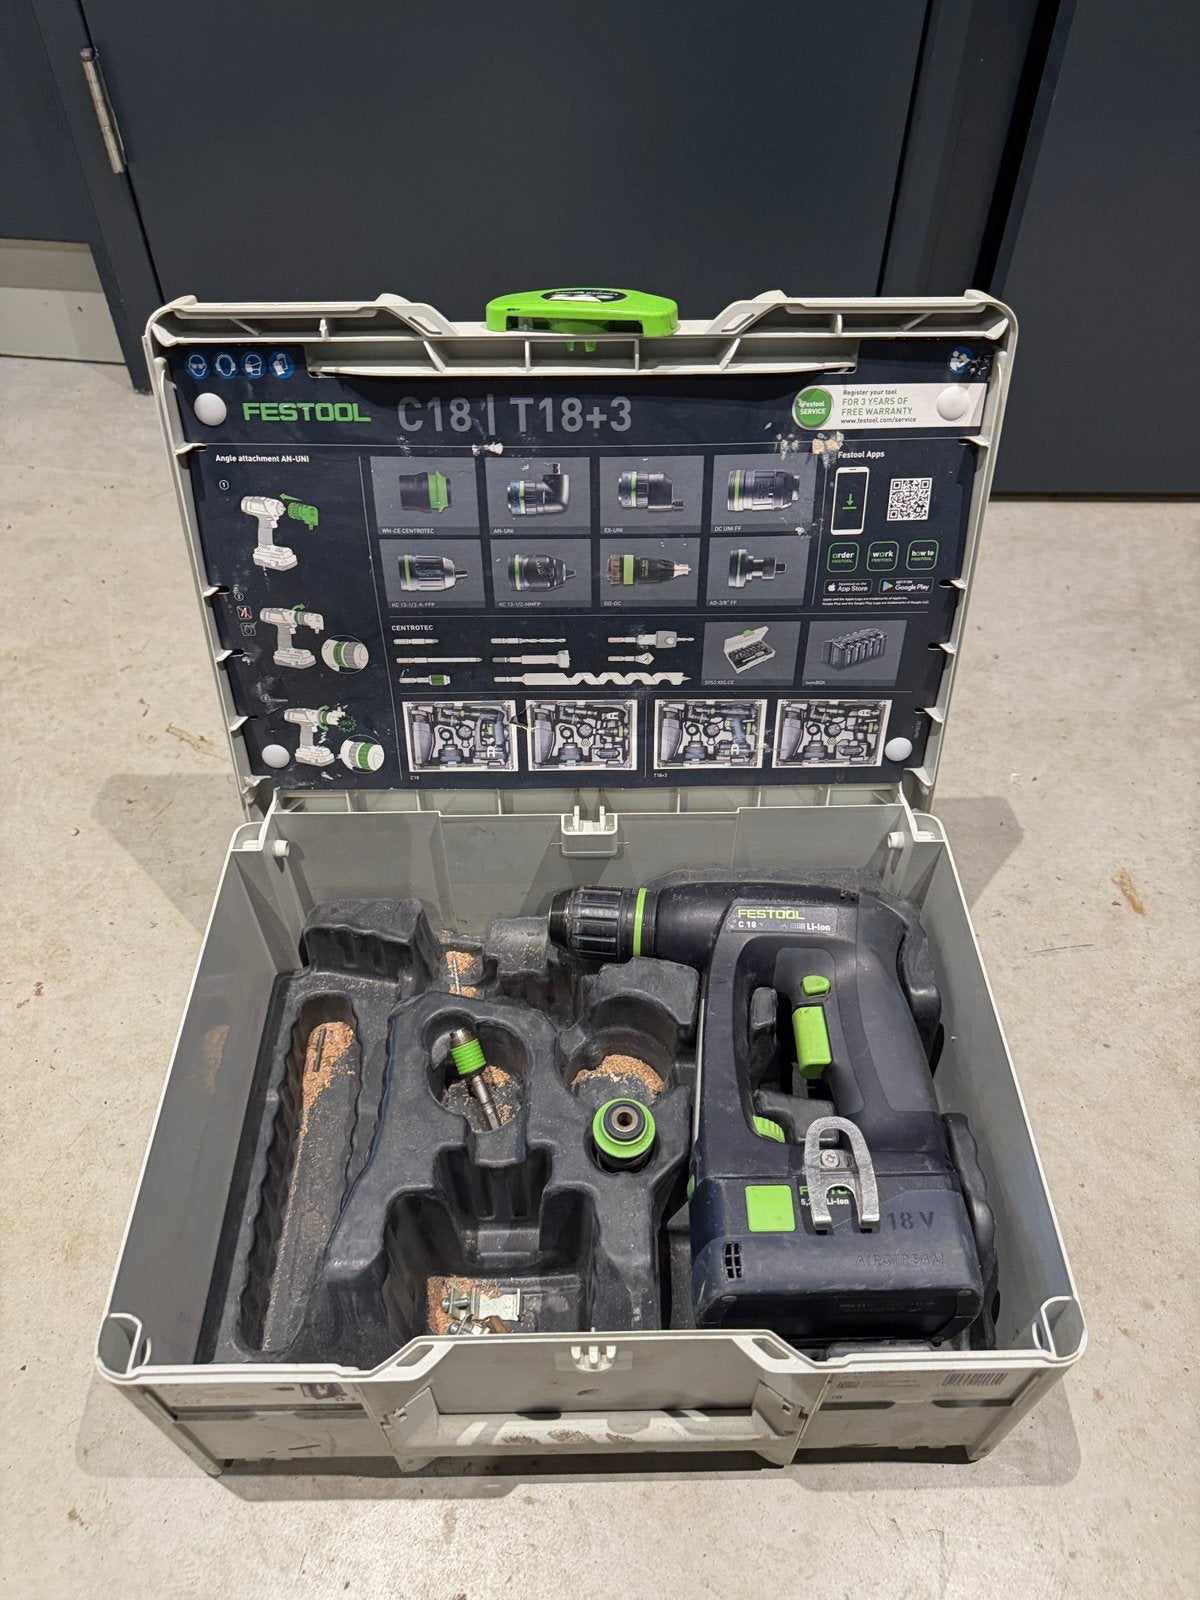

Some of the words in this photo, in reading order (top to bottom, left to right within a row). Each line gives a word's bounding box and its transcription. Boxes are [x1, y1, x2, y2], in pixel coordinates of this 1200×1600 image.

[842, 389, 869, 397] Register
[884, 388, 897, 396] tool
[842, 398, 860, 406] FOR
[861, 398, 866, 406] 3
[868, 397, 895, 406] YEARS
[897, 396, 909, 405] OF
[242, 402, 372, 422] FESTOOL
[397, 396, 472, 432] C18
[509, 396, 632, 433] T18+3
[799, 407, 826, 415] SERVICE
[841, 408, 864, 416] FREE
[865, 406, 913, 415] WARRANTY
[840, 416, 917, 424] www.festool.com/service
[215, 454, 237, 464] Angle
[238, 454, 280, 463] attachment
[281, 454, 310, 463] AN-UNI
[837, 451, 865, 459] Festool
[866, 450, 885, 459] Apps
[872, 550, 894, 558] work
[911, 549, 926, 557] how
[894, 584, 917, 592] Google
[916, 583, 930, 591] Play
[391, 624, 434, 632] CENTROTEC
[737, 909, 805, 920] FESTOOL
[806, 922, 831, 931] Li-Ion
[826, 1197, 850, 1205] Li-Ion
[887, 1212, 914, 1230] 18
[919, 1211, 935, 1229] V
[856, 1253, 945, 1266] AIRSTREAM
